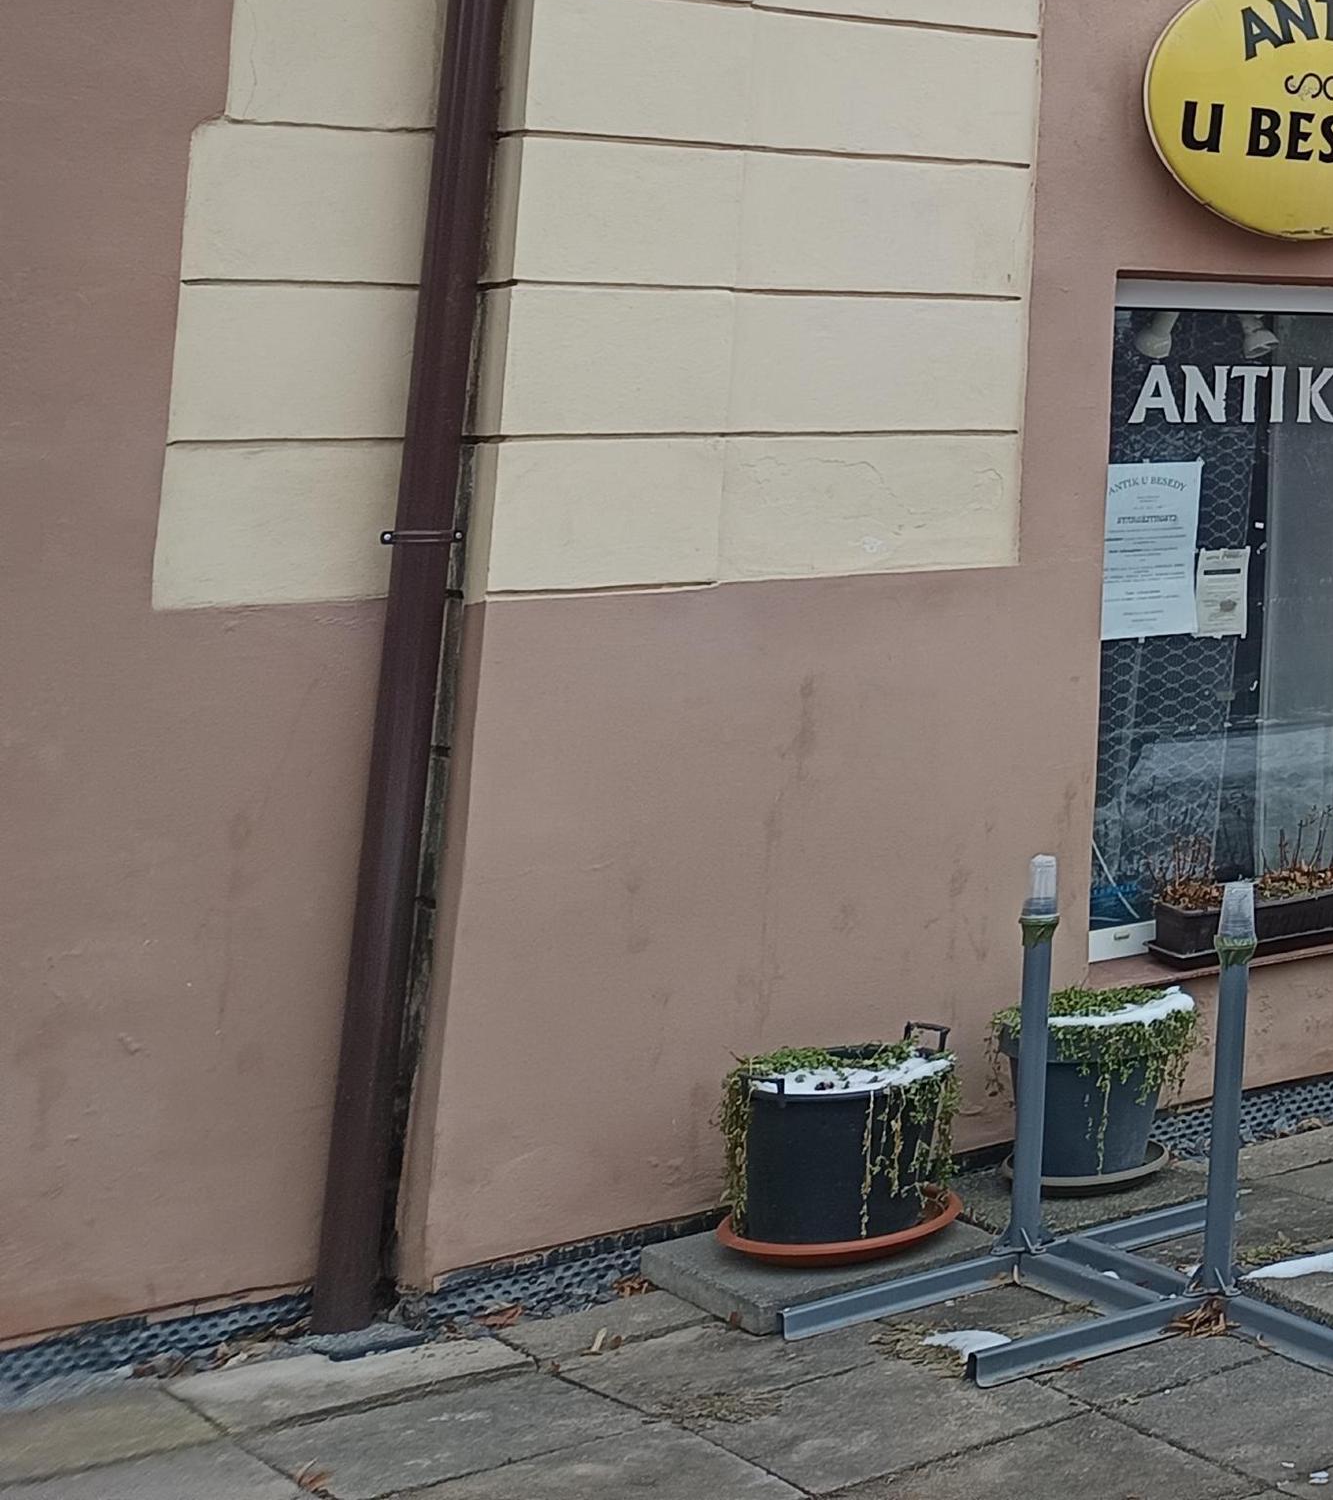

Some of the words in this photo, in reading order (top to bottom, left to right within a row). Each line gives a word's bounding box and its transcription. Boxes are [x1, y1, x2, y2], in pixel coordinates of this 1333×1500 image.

[1181, 101, 1225, 154] U
[1108, 476, 1139, 496] ANTIK
[1141, 476, 1149, 485] U
[1150, 476, 1187, 492] BESEDY
